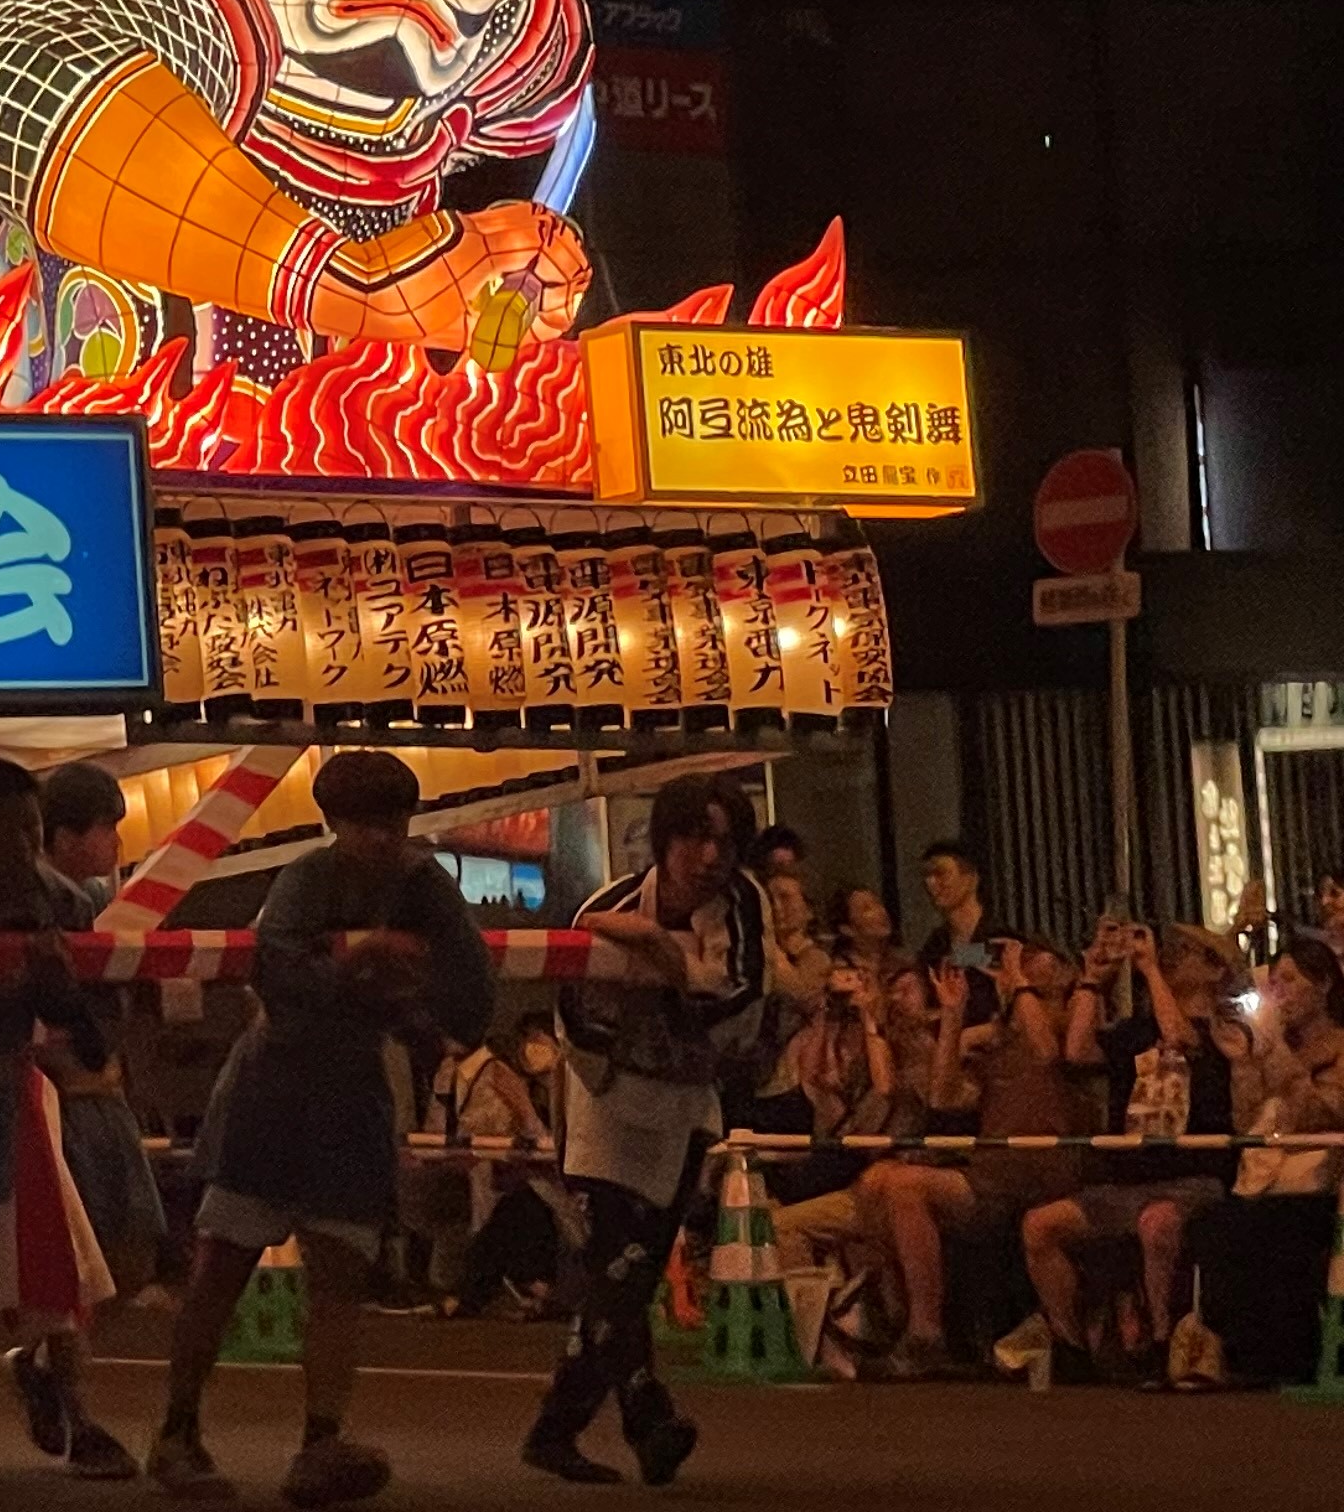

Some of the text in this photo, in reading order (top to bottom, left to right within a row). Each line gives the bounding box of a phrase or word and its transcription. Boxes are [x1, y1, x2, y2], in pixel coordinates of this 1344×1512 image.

[658, 344, 774, 379] 東北の雄
[407, 551, 470, 699] 日本原燃
[568, 557, 625, 689] 電源開発
